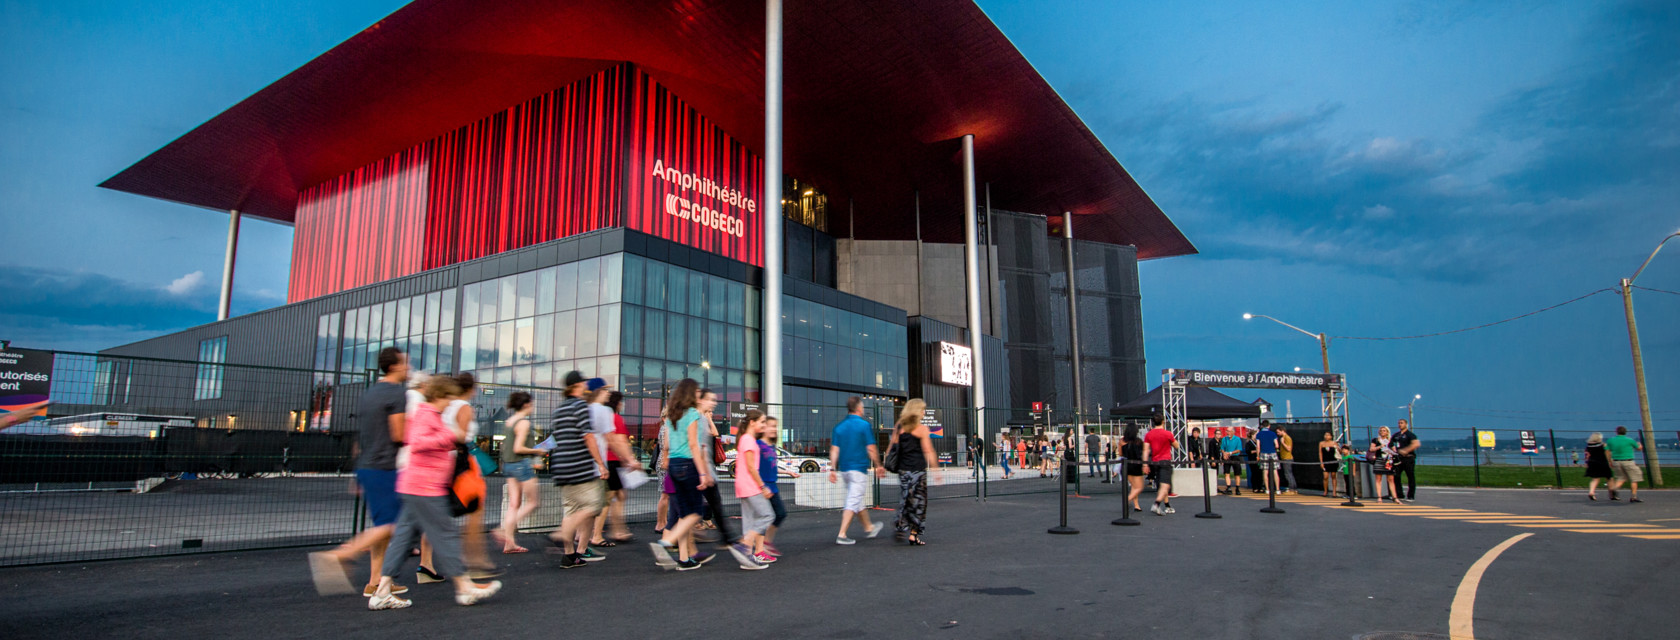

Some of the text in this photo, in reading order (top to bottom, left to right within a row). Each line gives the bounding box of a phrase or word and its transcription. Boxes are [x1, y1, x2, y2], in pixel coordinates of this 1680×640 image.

[652, 159, 756, 213] Amphithéâtre
[691, 202, 744, 238] COGECO
[1194, 372, 1246, 383] Bienvenue
[1247, 374, 1254, 383] à
[1255, 374, 1324, 386] l'Amphithéâtre
